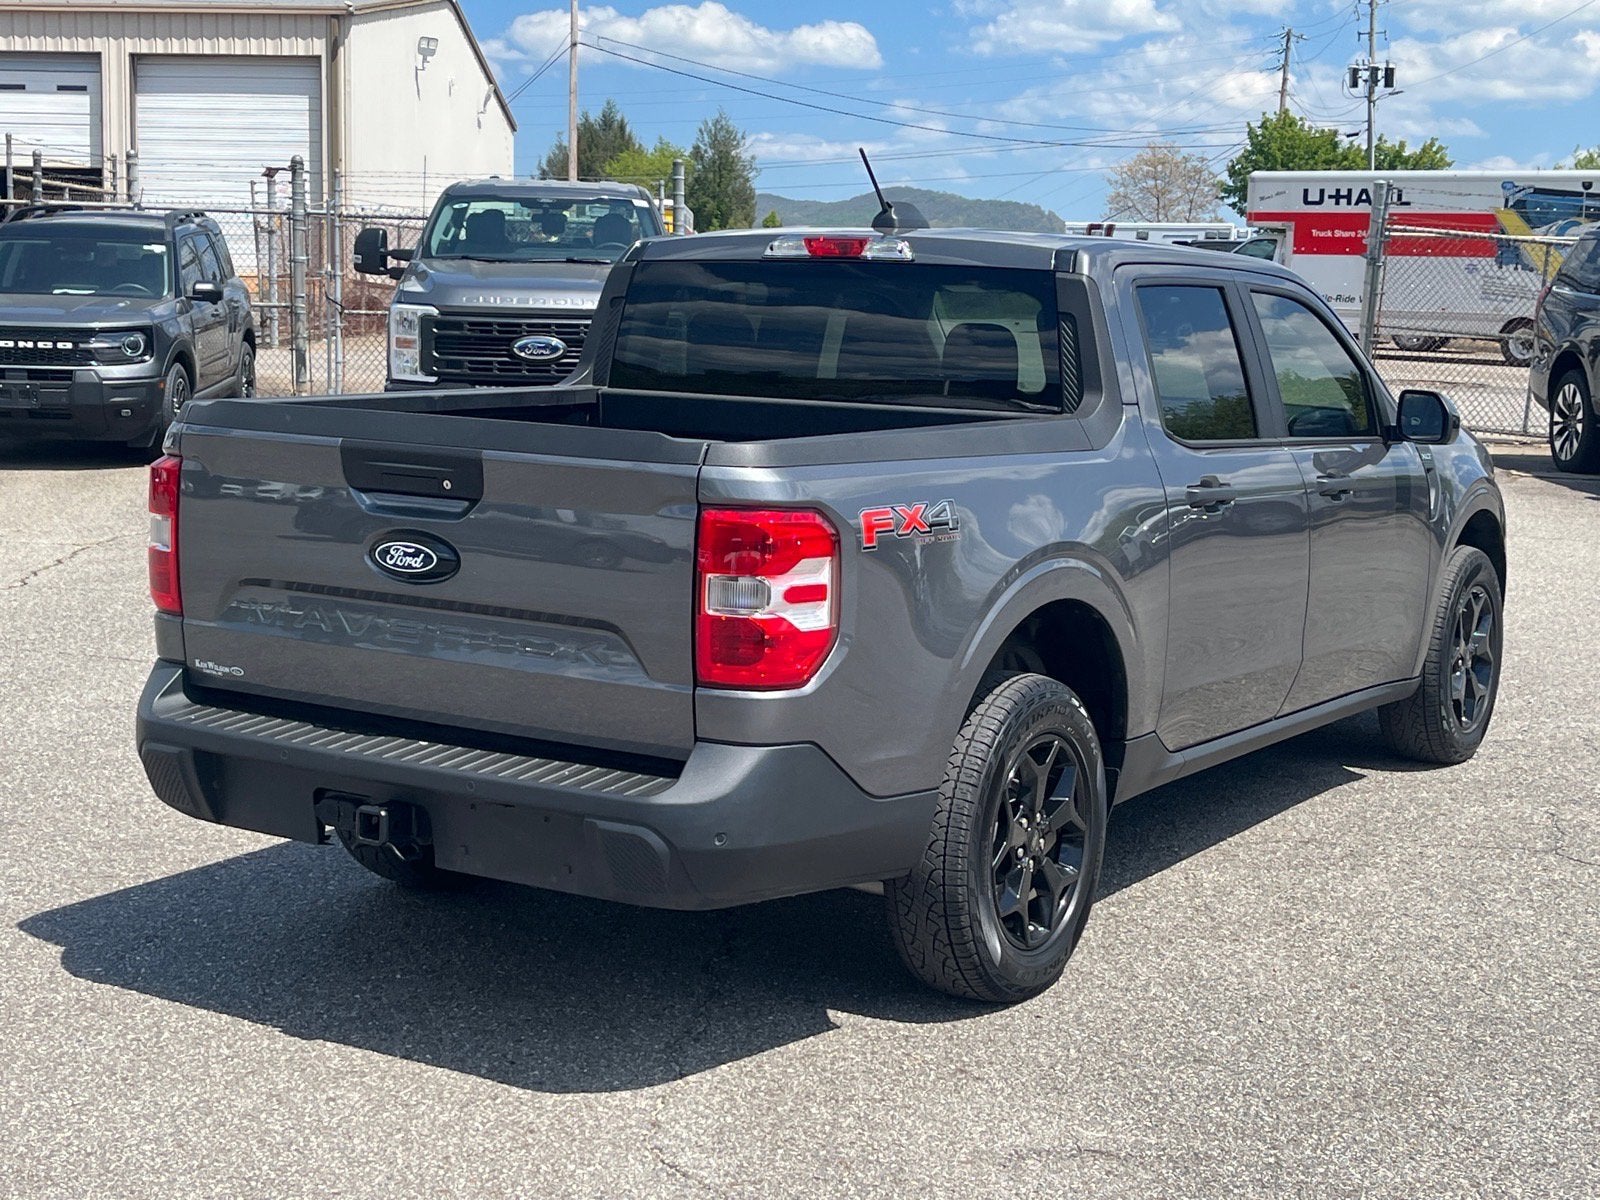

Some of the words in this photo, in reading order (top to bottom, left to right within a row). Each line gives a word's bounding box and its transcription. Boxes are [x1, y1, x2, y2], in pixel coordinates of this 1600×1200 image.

[1302, 187, 1412, 207] U-HAL
[1311, 229, 1333, 238] Truck
[1334, 229, 1356, 238] Share
[858, 498, 960, 552] FX4
[385, 545, 425, 568] Ford
